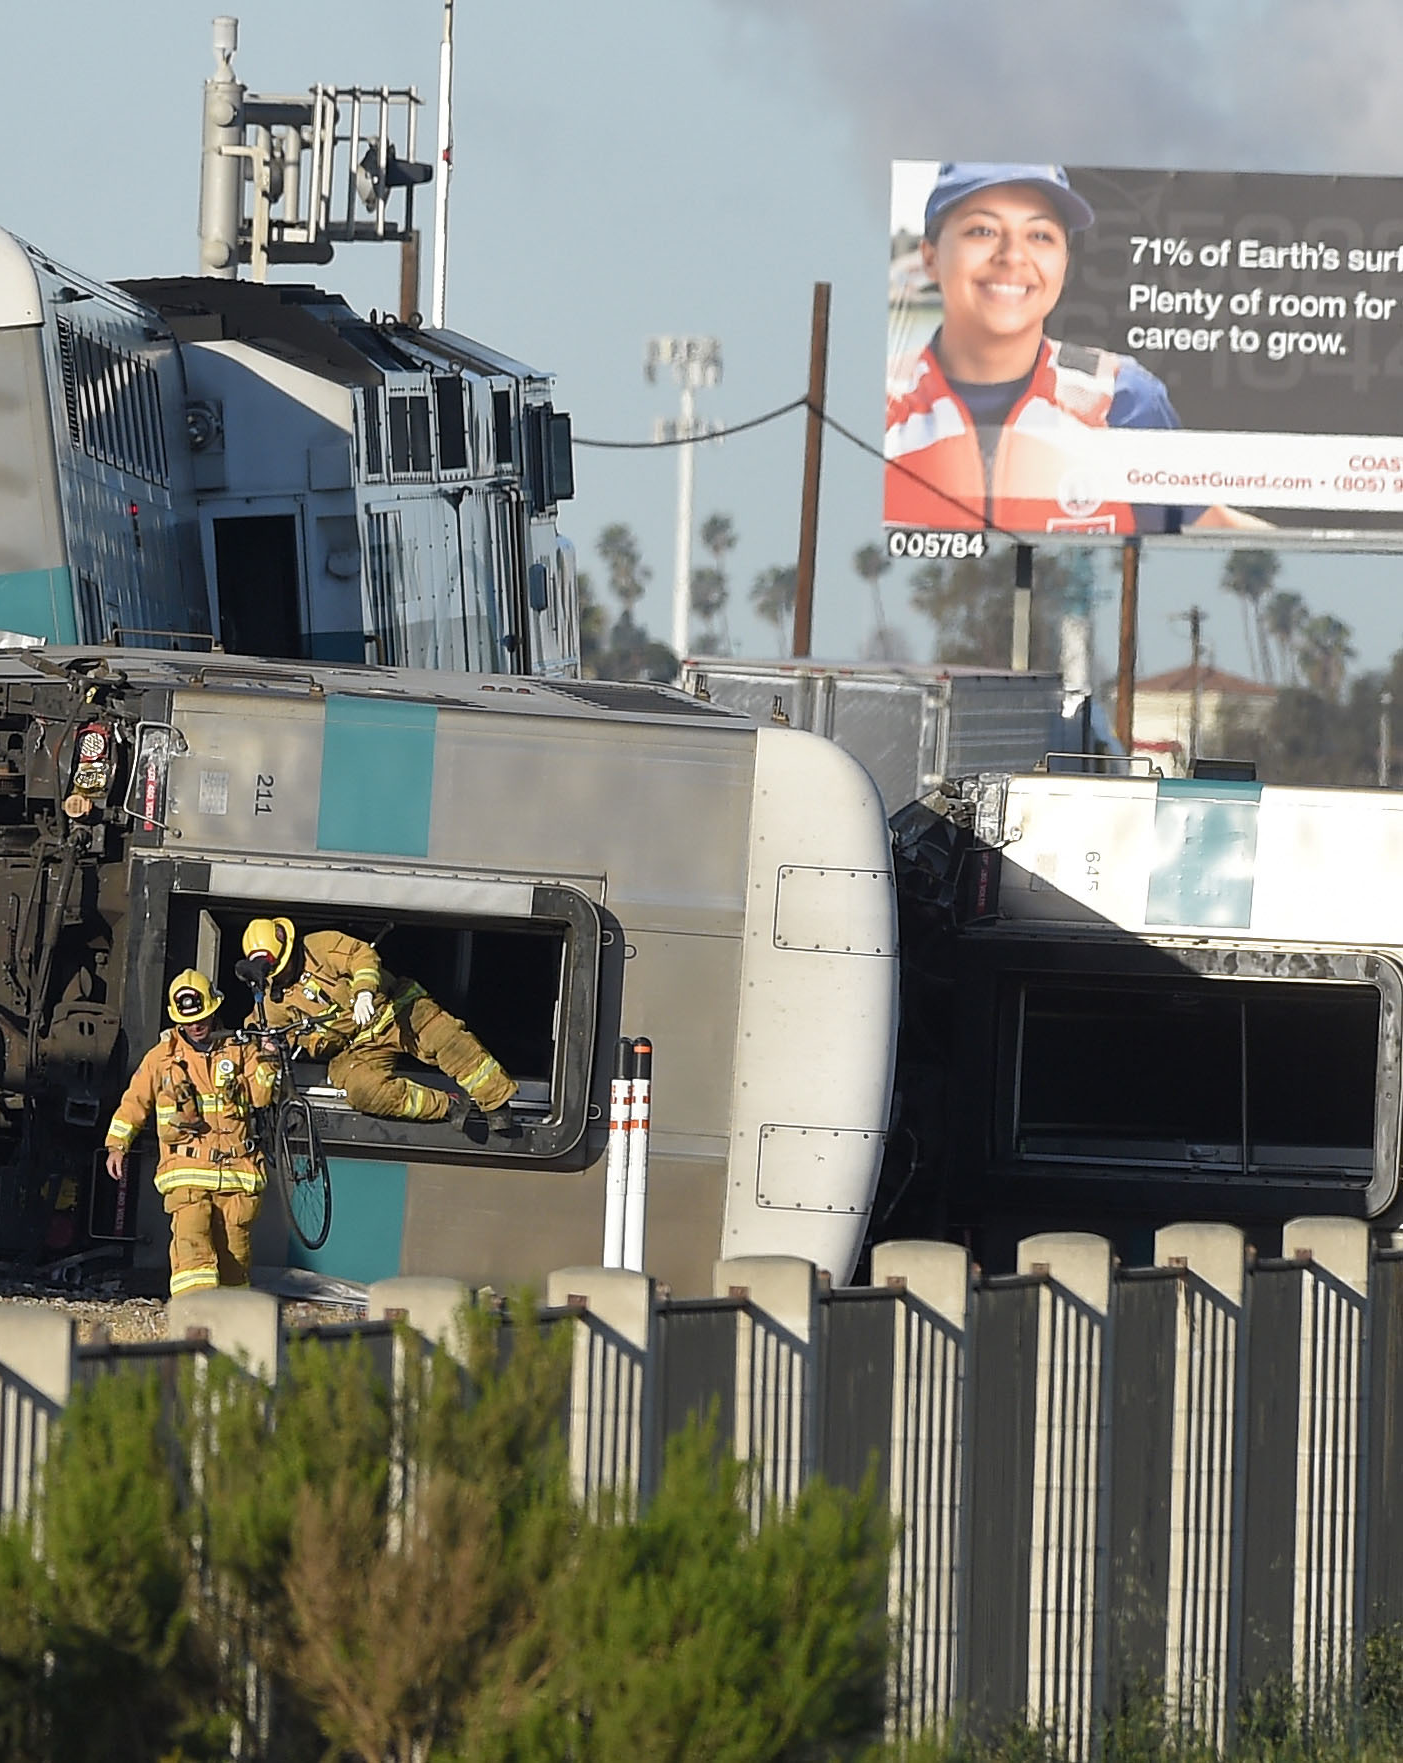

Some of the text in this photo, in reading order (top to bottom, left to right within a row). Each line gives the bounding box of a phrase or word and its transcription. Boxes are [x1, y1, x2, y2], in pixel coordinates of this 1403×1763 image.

[1130, 236, 1194, 266] 71%
[1199, 239, 1232, 268] of
[1238, 239, 1341, 271] Earth's
[1129, 284, 1397, 321] Plenty of room for
[1127, 325, 1347, 361] career to grow.
[1126, 469, 1312, 491] GoCoastGuard.com
[1333, 474, 1386, 493] (805)
[1348, 455, 1403, 473] COAS
[889, 532, 985, 560] 005784
[254, 774, 275, 817] 211
[1085, 851, 1101, 891] 645
